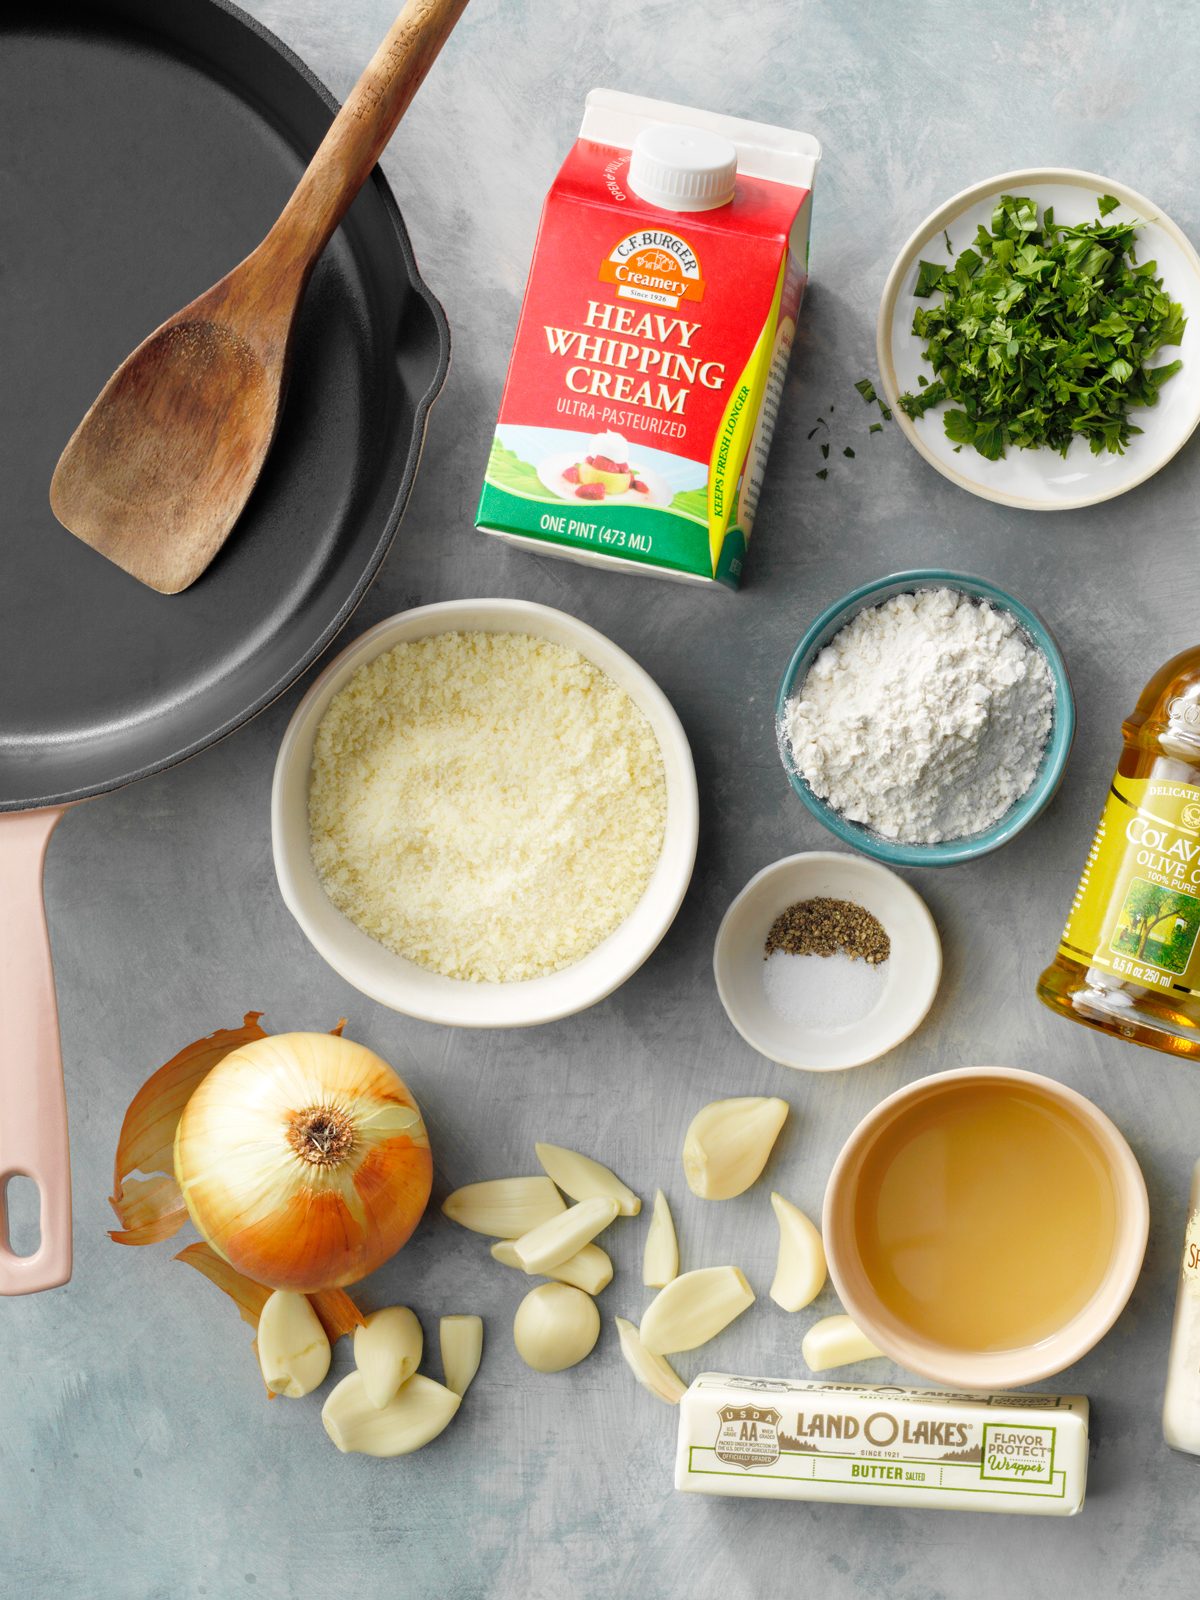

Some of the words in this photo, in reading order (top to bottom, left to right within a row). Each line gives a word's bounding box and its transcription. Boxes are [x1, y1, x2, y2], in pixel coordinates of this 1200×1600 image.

[604, 160, 624, 174] PULL
[605, 181, 626, 201] OPEN
[642, 232, 697, 273] BURGER
[615, 265, 689, 296] Creamery
[630, 289, 649, 299] Since
[650, 292, 667, 303] 1926
[583, 300, 702, 349] HEAVY
[543, 325, 726, 390] WHIPPING
[565, 365, 690, 415] CREAM
[556, 397, 687, 439] ULTRA-PASTEURIZED
[725, 385, 751, 437] LONGER
[716, 436, 731, 477] FRESH
[714, 478, 724, 518] KEEPS
[540, 514, 567, 534] ONE
[567, 519, 598, 540] PINT
[598, 525, 627, 546] (473
[627, 532, 653, 553] ML)
[1150, 786, 1200, 802] DELICATE
[1136, 849, 1188, 879] OLIVE
[1148, 871, 1169, 886] 100%
[1171, 880, 1198, 894] PURE
[1132, 967, 1144, 978] oz
[1143, 968, 1160, 984] 250
[1160, 975, 1173, 988] ml
[726, 1410, 773, 1423] USDA
[739, 1421, 758, 1441] AA
[796, 1412, 860, 1440] LAND
[863, 1411, 900, 1448] O
[902, 1419, 969, 1448] LAKES
[994, 1433, 1043, 1446] FLAVOR
[860, 1449, 882, 1458] SINCE
[988, 1443, 1047, 1457] PROTECT
[851, 1463, 904, 1481] BUTTER
[905, 1471, 926, 1482] SALTED
[987, 1454, 1045, 1476] Wrapper
